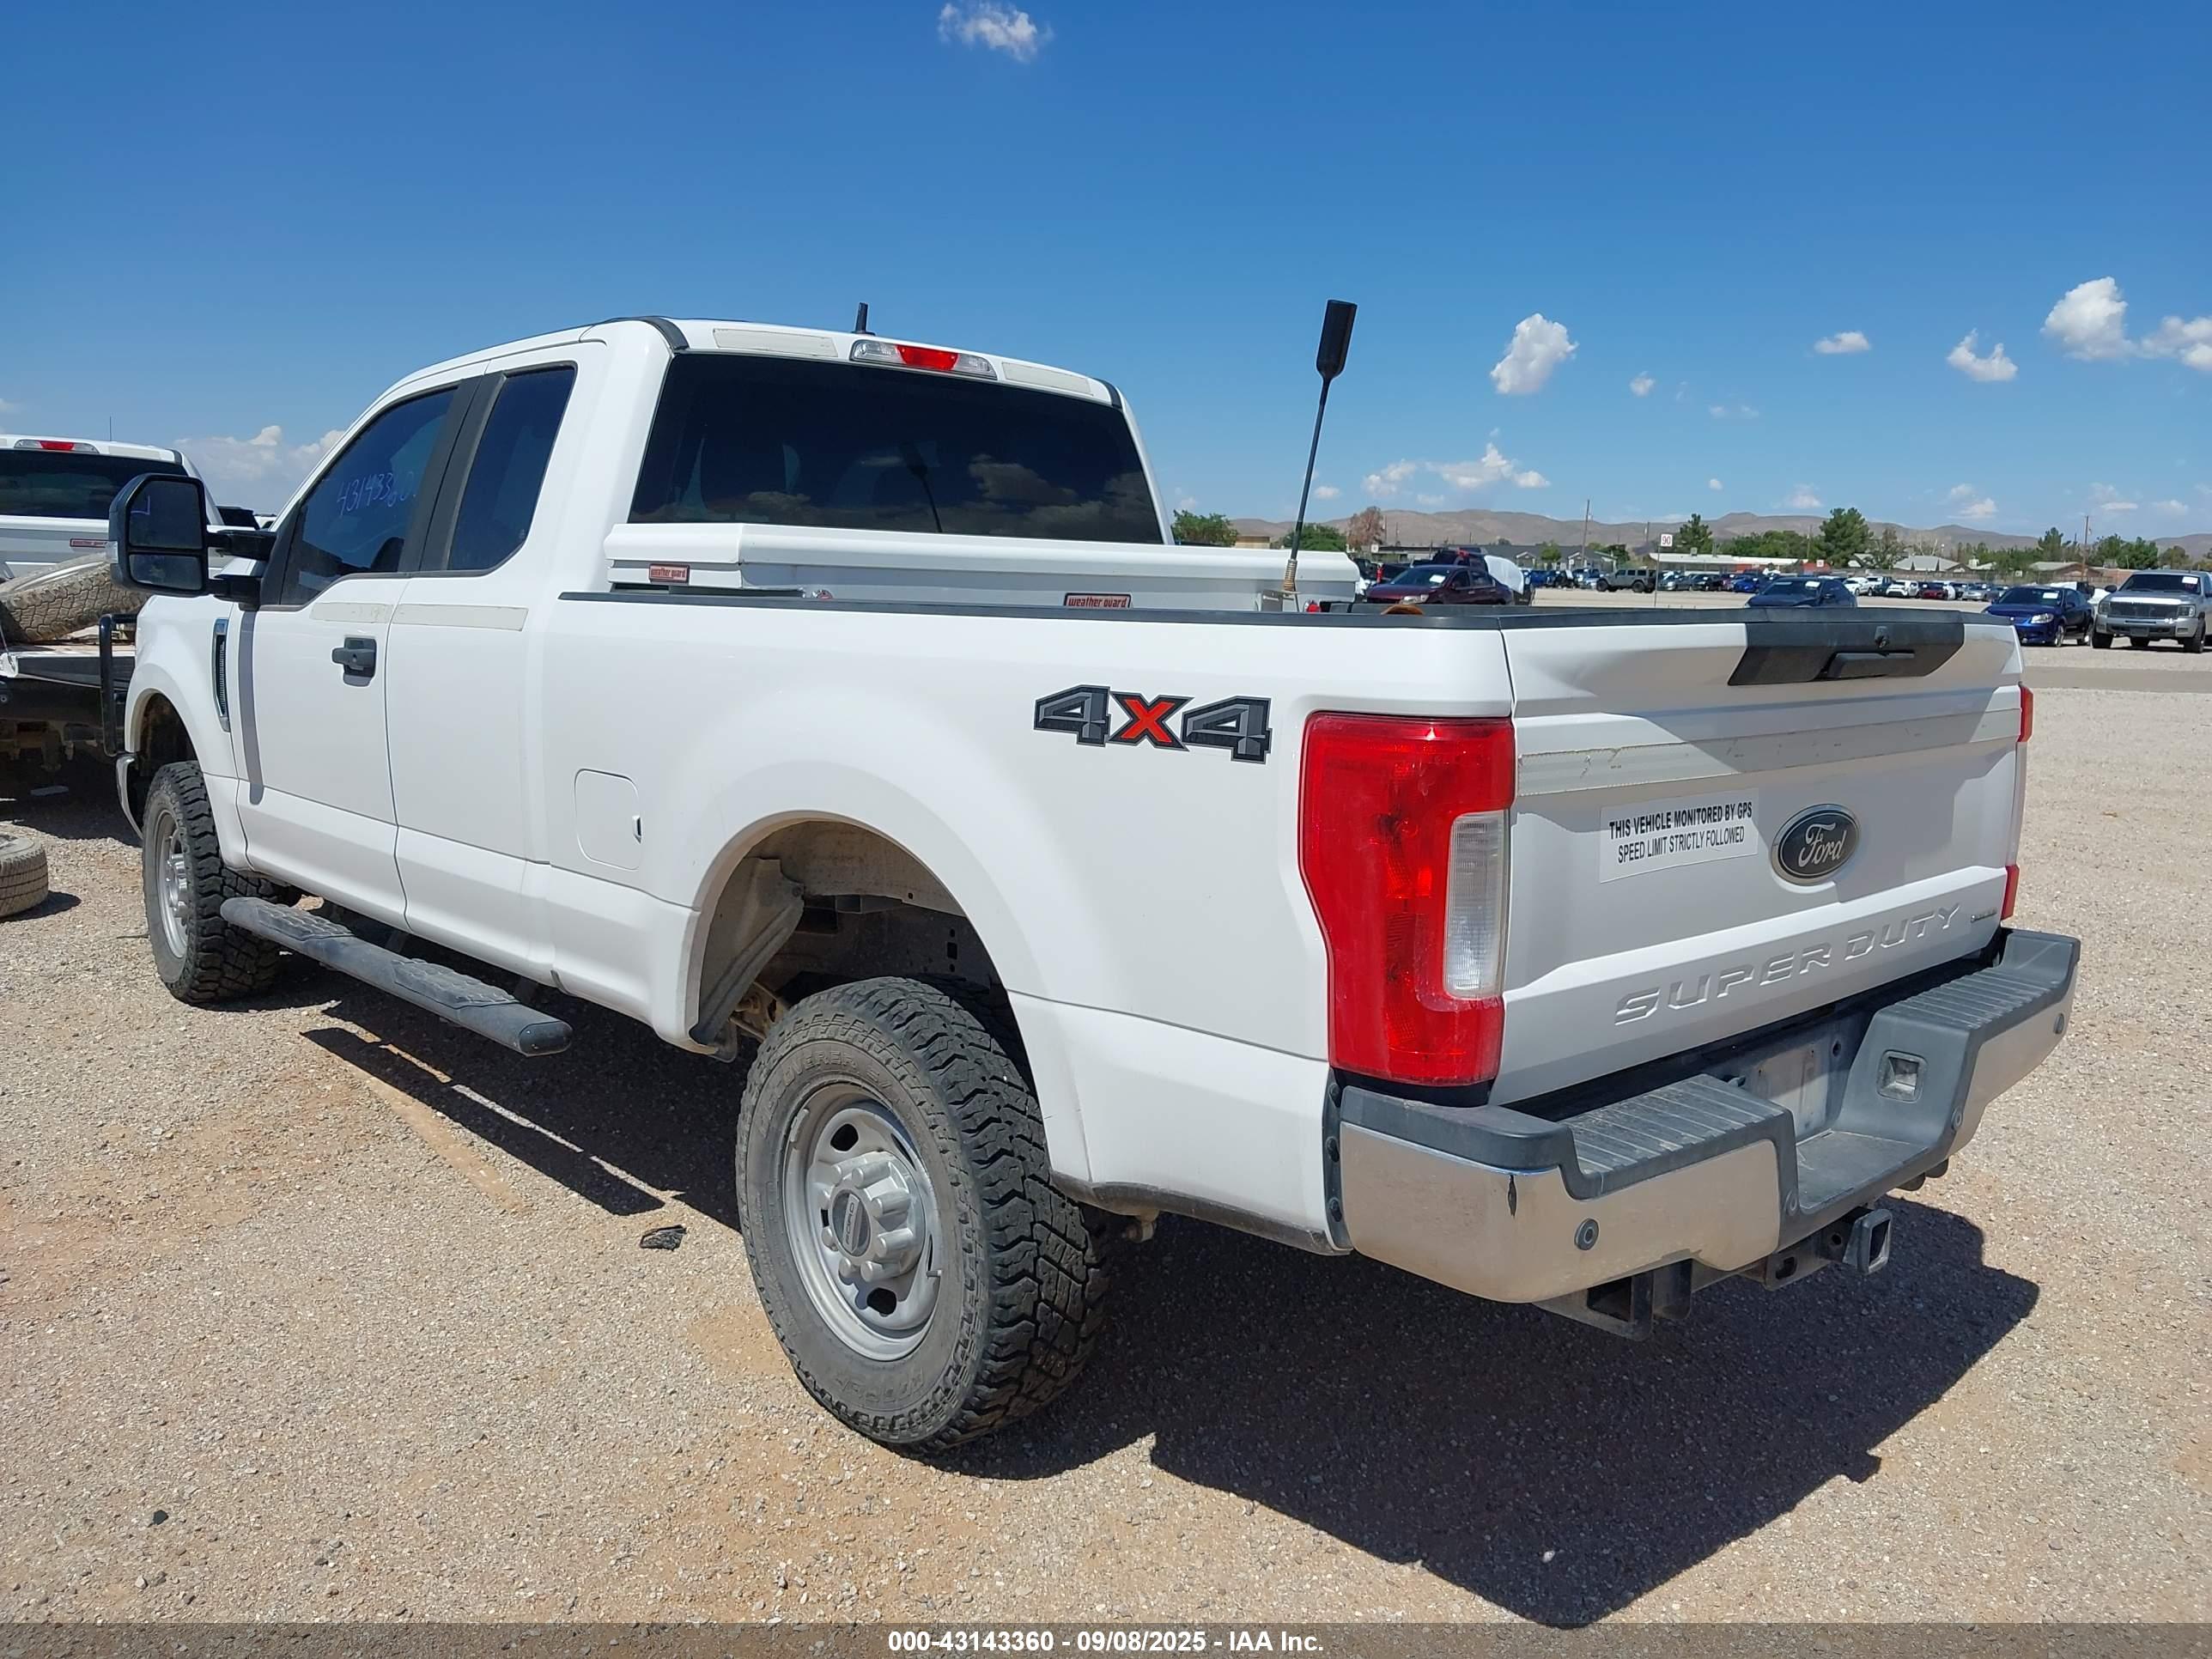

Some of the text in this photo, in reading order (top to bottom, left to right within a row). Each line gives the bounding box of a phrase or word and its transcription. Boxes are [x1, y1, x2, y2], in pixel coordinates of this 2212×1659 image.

[1068, 596, 1103, 608] weather
[1609, 801, 1753, 840] THIS VEHICLE MONITORED BY GPS
[1618, 826, 1745, 864] SPEED LIMIT STRICTLY FOLLOWED
[1798, 822, 1848, 867] Ford
[1614, 903, 1960, 1025] SUPER DUTY
